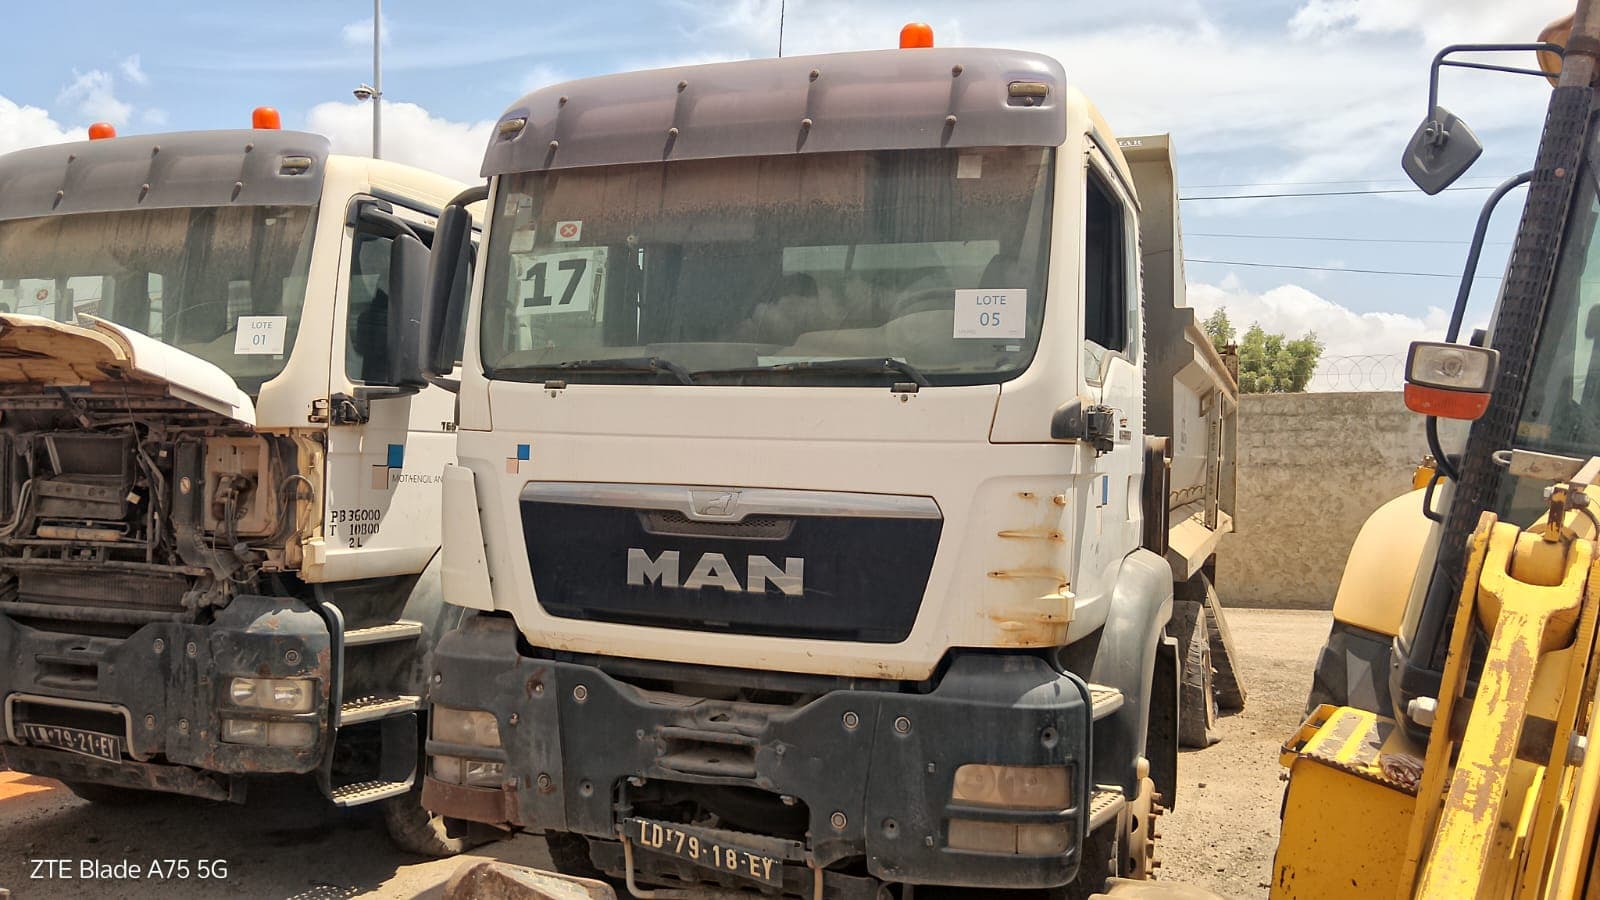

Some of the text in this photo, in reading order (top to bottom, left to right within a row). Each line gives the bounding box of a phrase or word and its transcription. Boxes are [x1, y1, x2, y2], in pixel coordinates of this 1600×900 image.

[522, 259, 587, 307] 17
[976, 295, 1007, 306] LOTE
[251, 321, 273, 329] LOTE
[980, 312, 1001, 327] 05
[252, 334, 266, 346] 01
[331, 509, 381, 523] PB 36000
[329, 524, 337, 536] T
[627, 547, 804, 596] MAN
